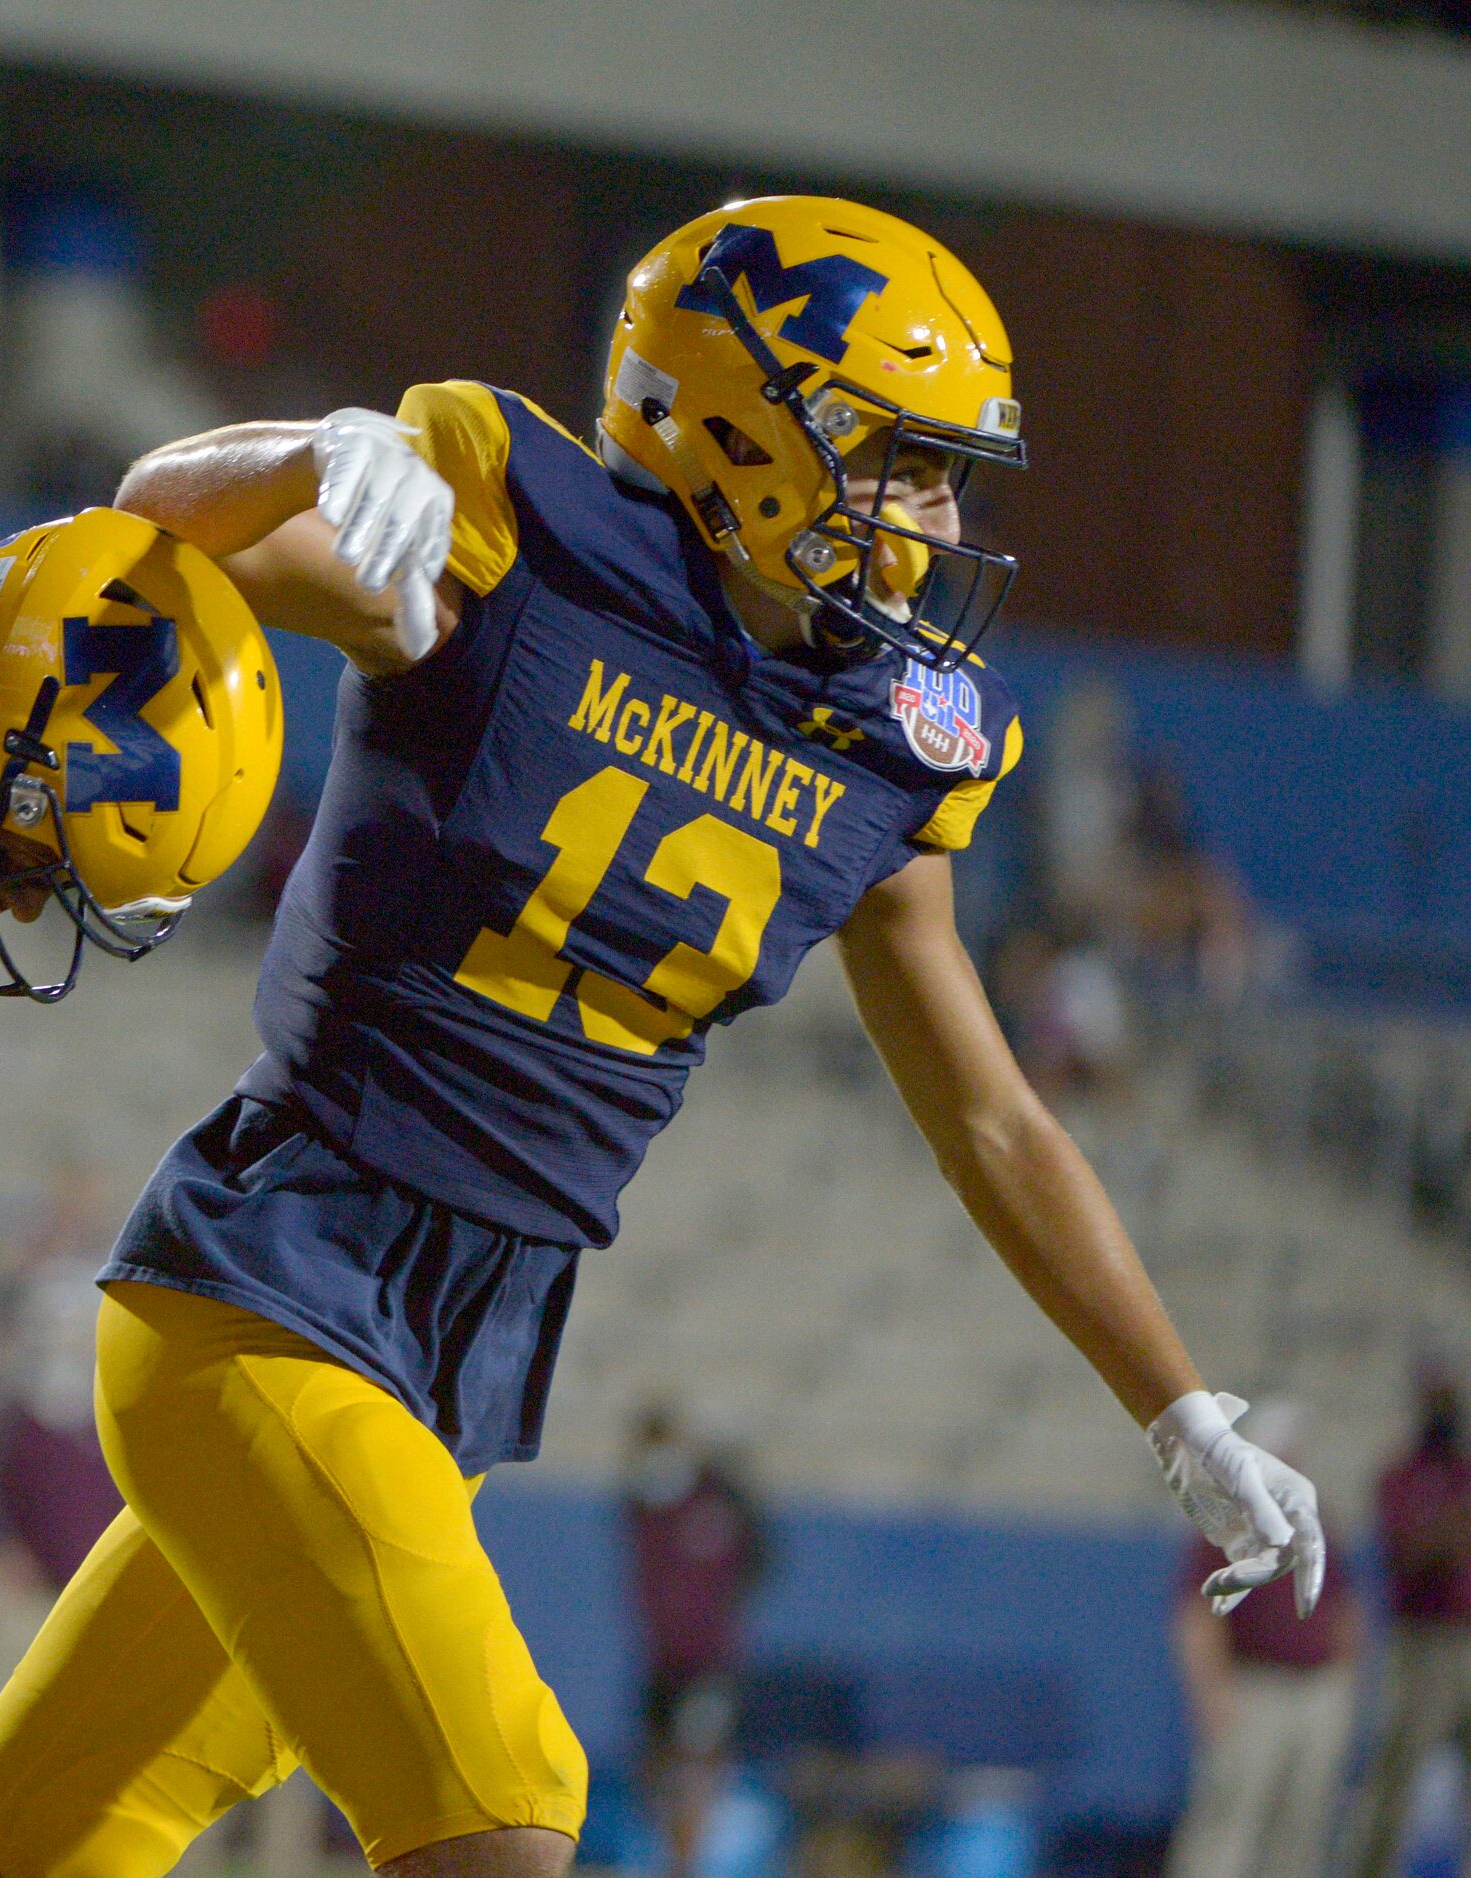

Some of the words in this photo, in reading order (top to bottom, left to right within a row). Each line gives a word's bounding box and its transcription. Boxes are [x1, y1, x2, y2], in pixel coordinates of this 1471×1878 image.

[675, 223, 890, 365] M
[62, 616, 181, 816] M
[568, 659, 846, 849] McKINNEY
[453, 765, 782, 1056] 13
